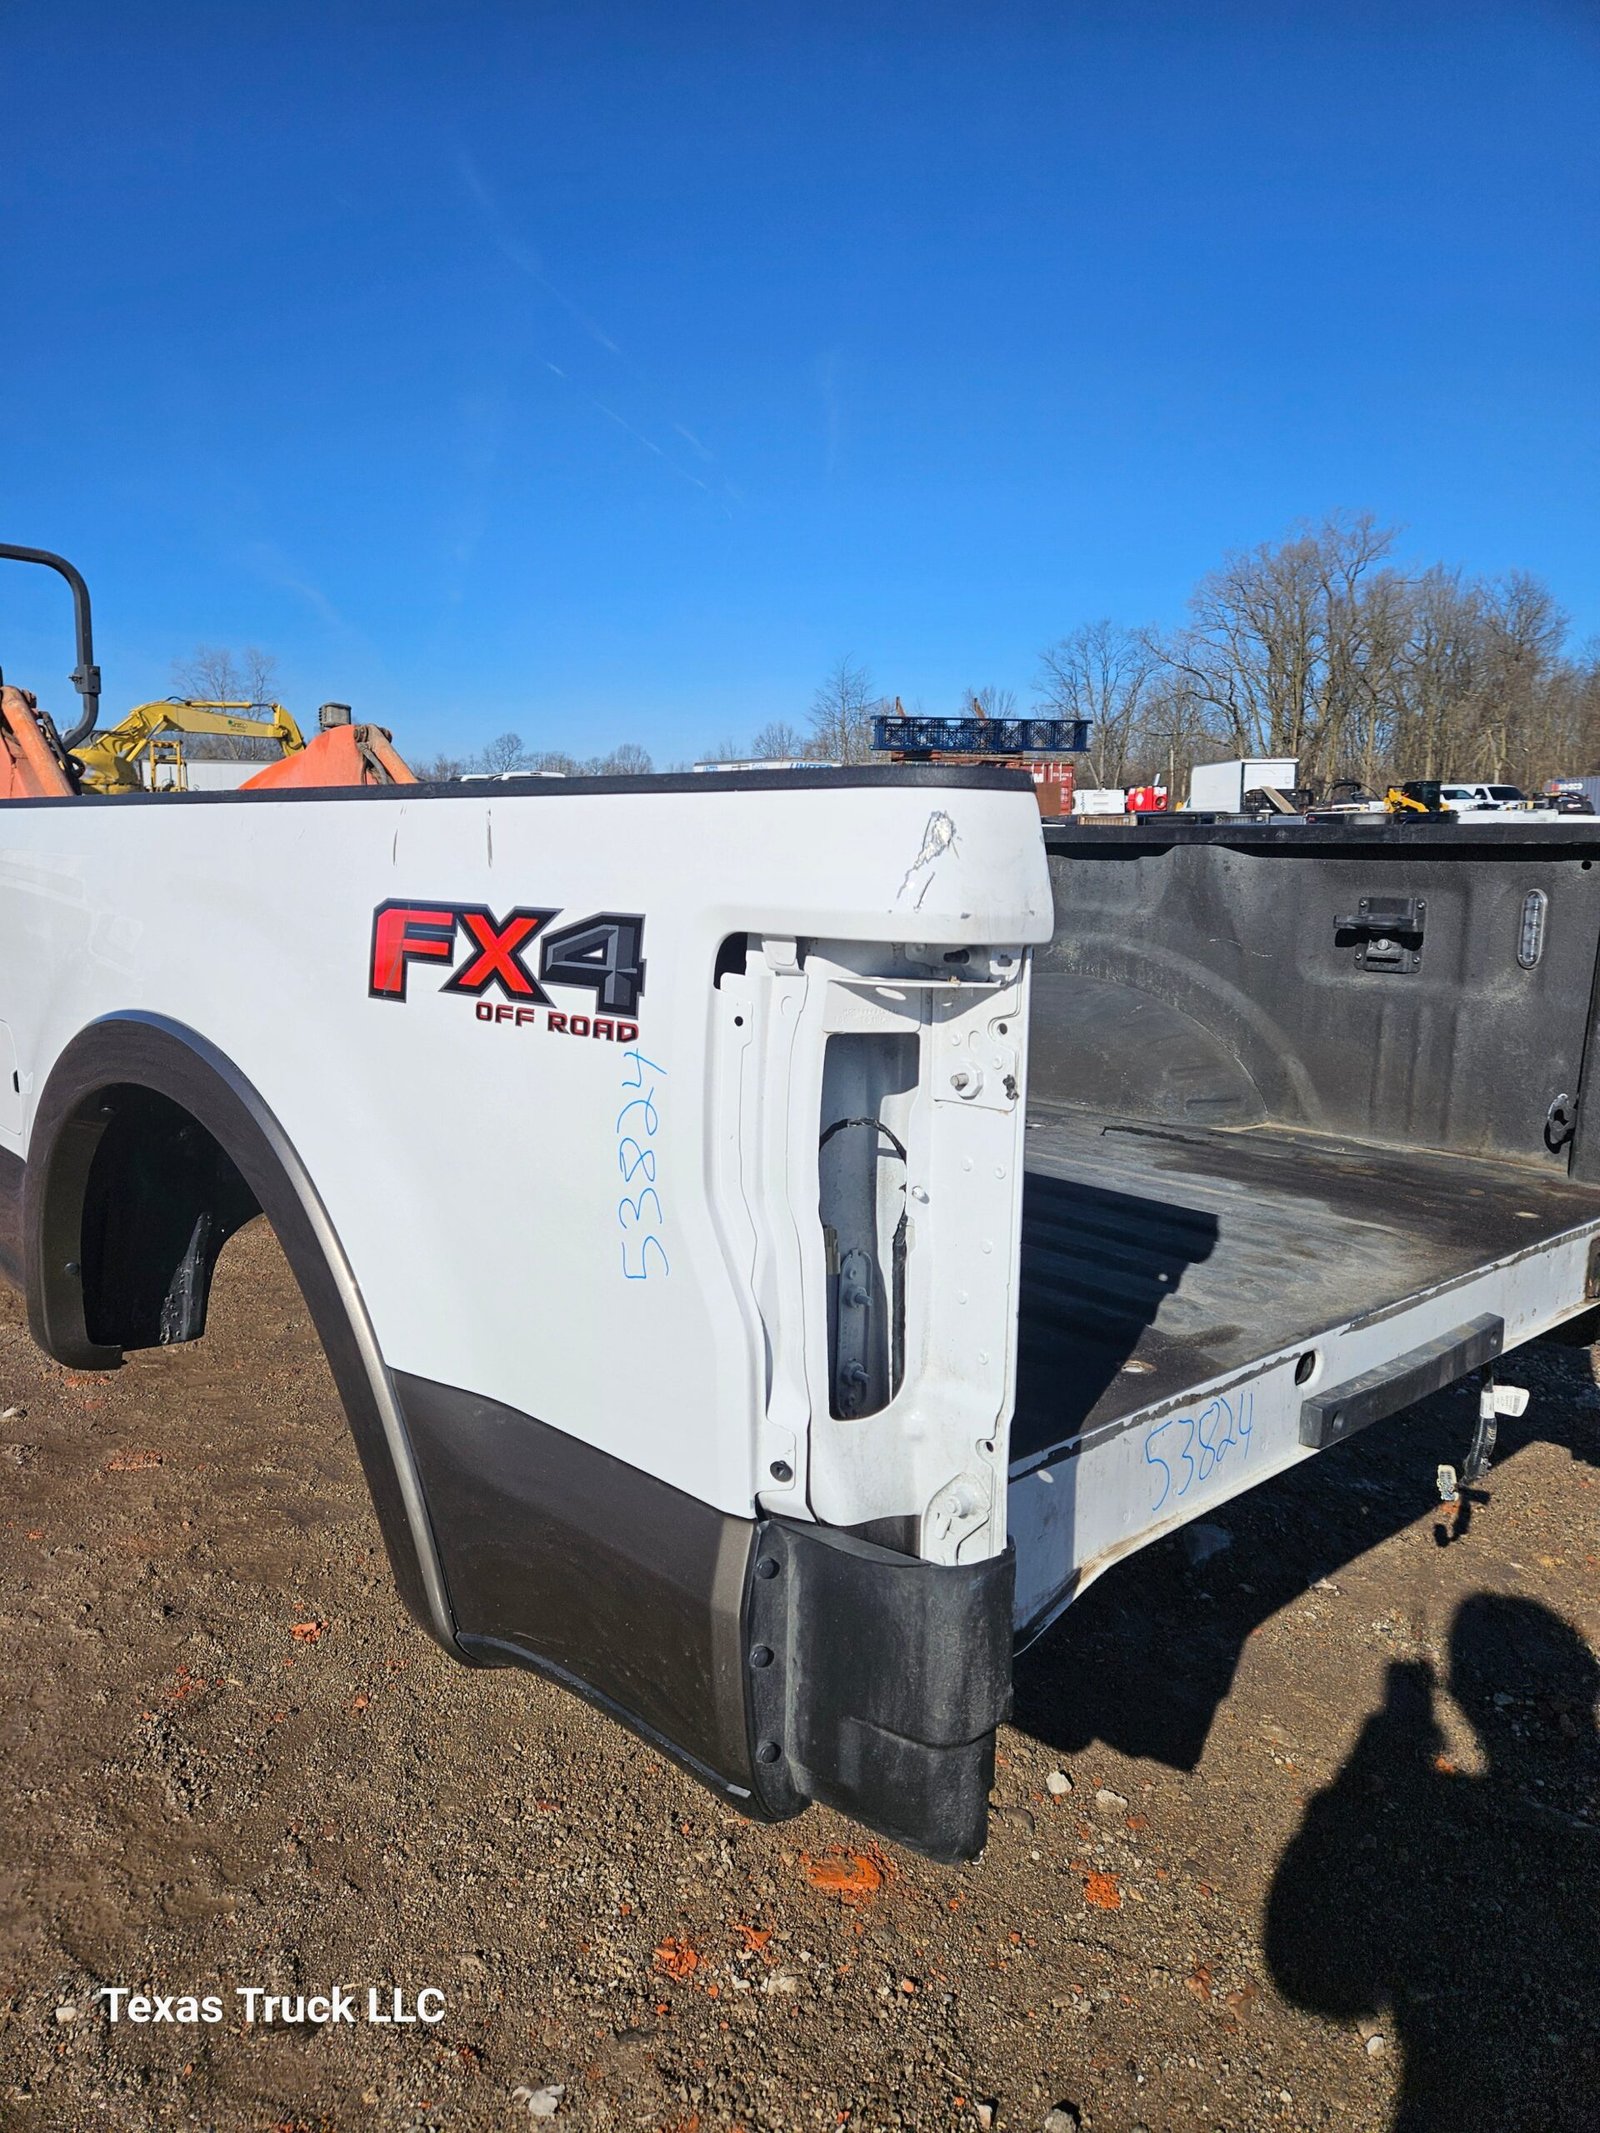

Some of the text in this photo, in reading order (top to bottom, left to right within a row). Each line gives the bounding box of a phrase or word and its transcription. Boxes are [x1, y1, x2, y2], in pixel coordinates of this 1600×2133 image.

[368, 897, 647, 1020] FX4
[475, 1001, 639, 1044] OFF ROAD
[617, 1048, 669, 1280] 53824
[1145, 1393, 1254, 1512] 53824
